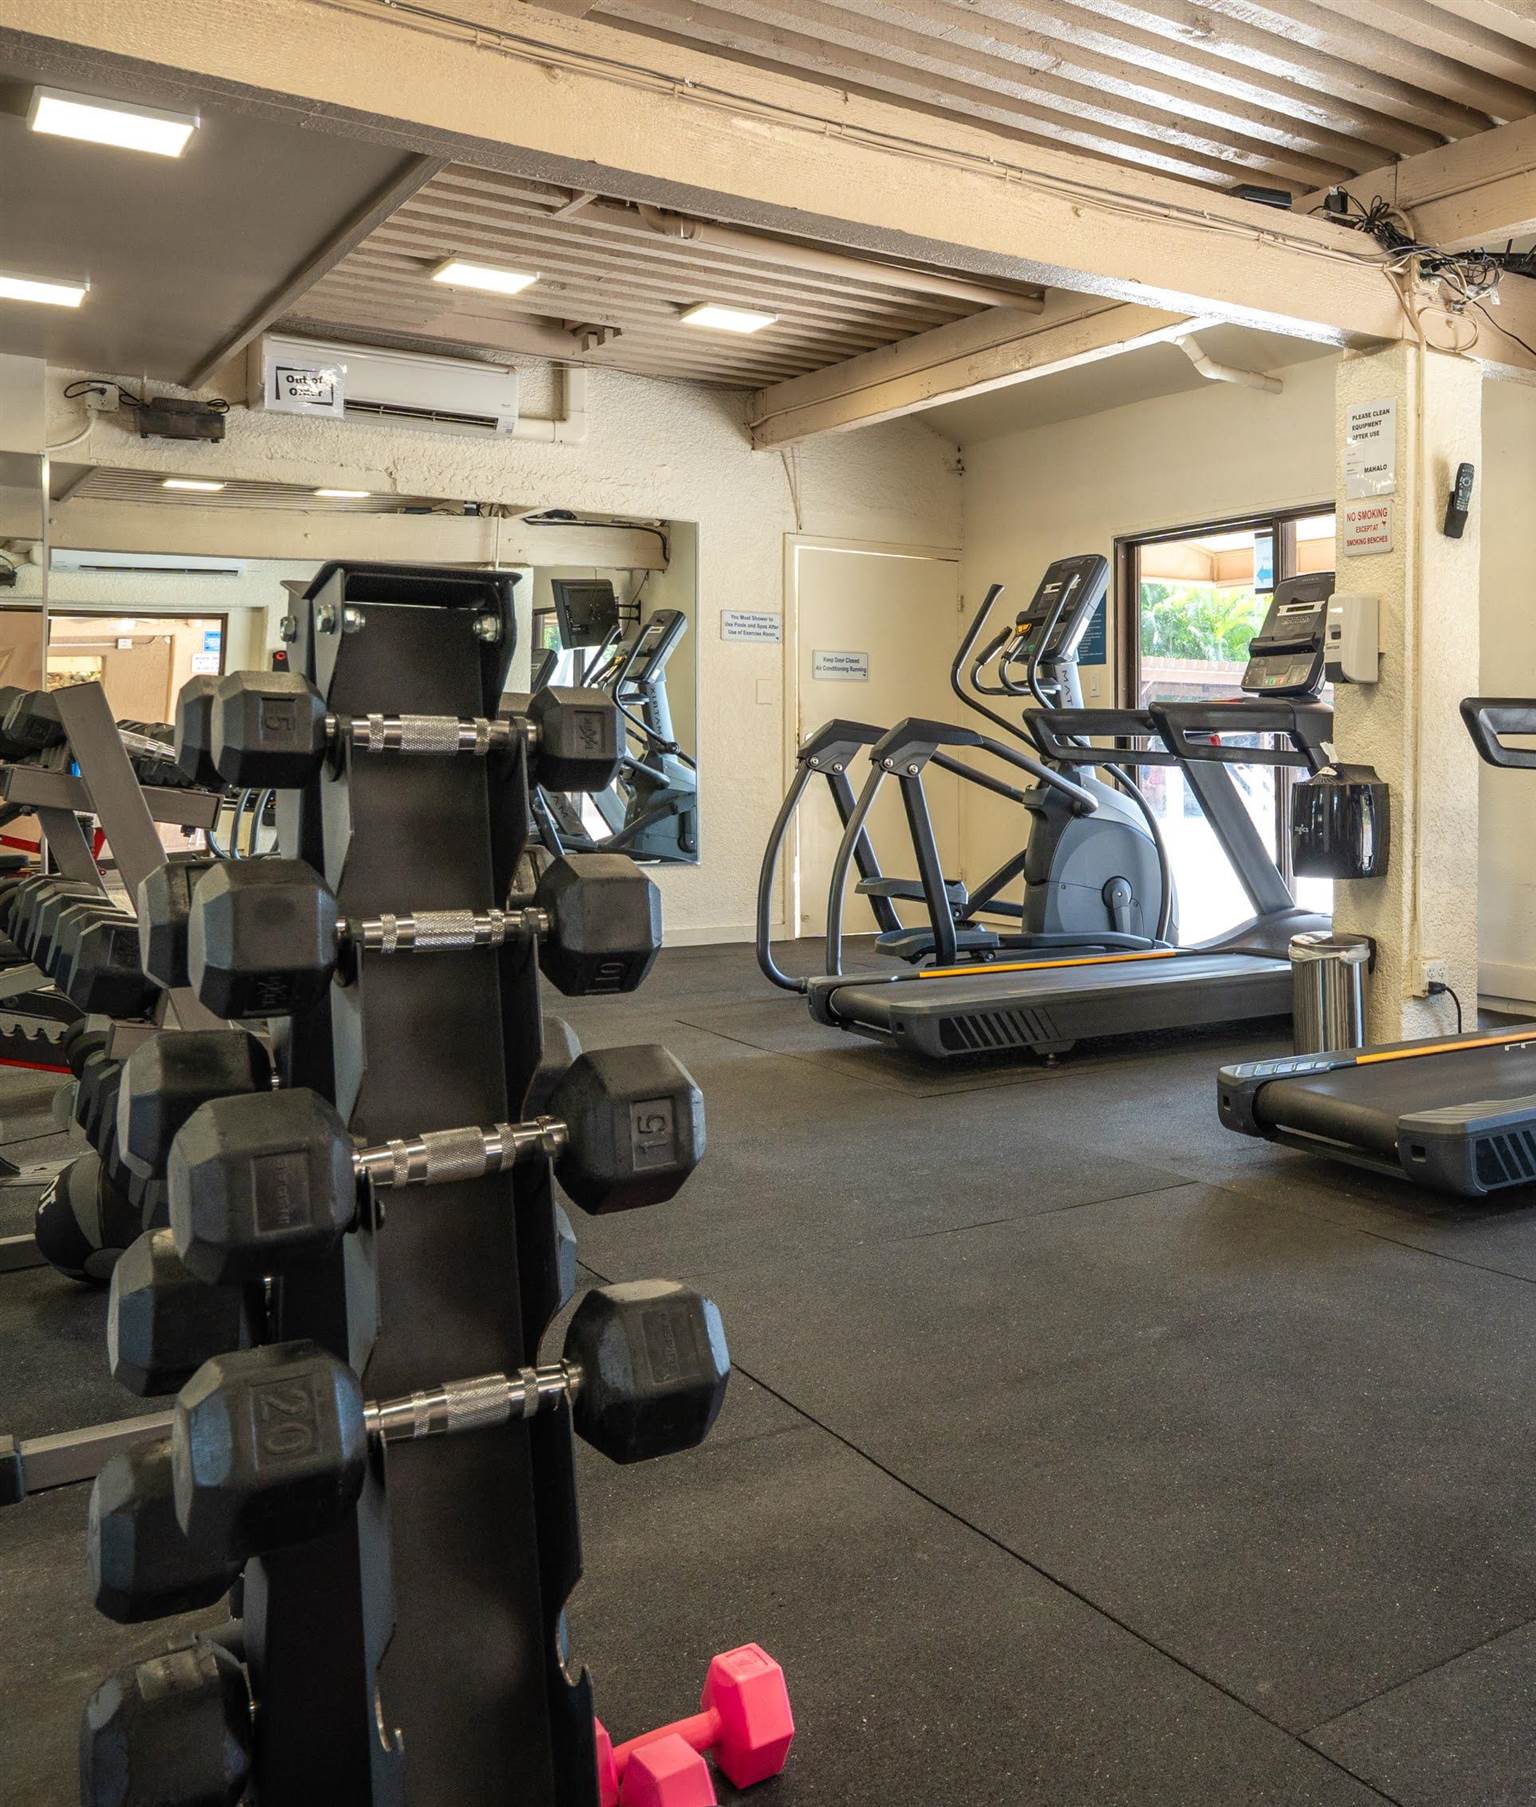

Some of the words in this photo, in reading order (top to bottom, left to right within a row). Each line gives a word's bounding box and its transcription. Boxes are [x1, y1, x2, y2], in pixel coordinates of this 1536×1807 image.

[286, 375, 307, 384] Out
[311, 376, 323, 384] of
[1352, 411, 1371, 421] PLEASE
[1372, 408, 1390, 417] CLEAN
[1352, 420, 1382, 431] EQUIPMENT
[1369, 430, 1380, 438] USE
[1364, 464, 1388, 473] MAHALO
[1346, 512, 1356, 522] NO
[1357, 507, 1388, 521] SMOKING
[1346, 538, 1367, 546] SMOKING
[1061, 670, 1074, 706] MAT
[637, 1113, 669, 1155] 15
[261, 1388, 313, 1457] 20
